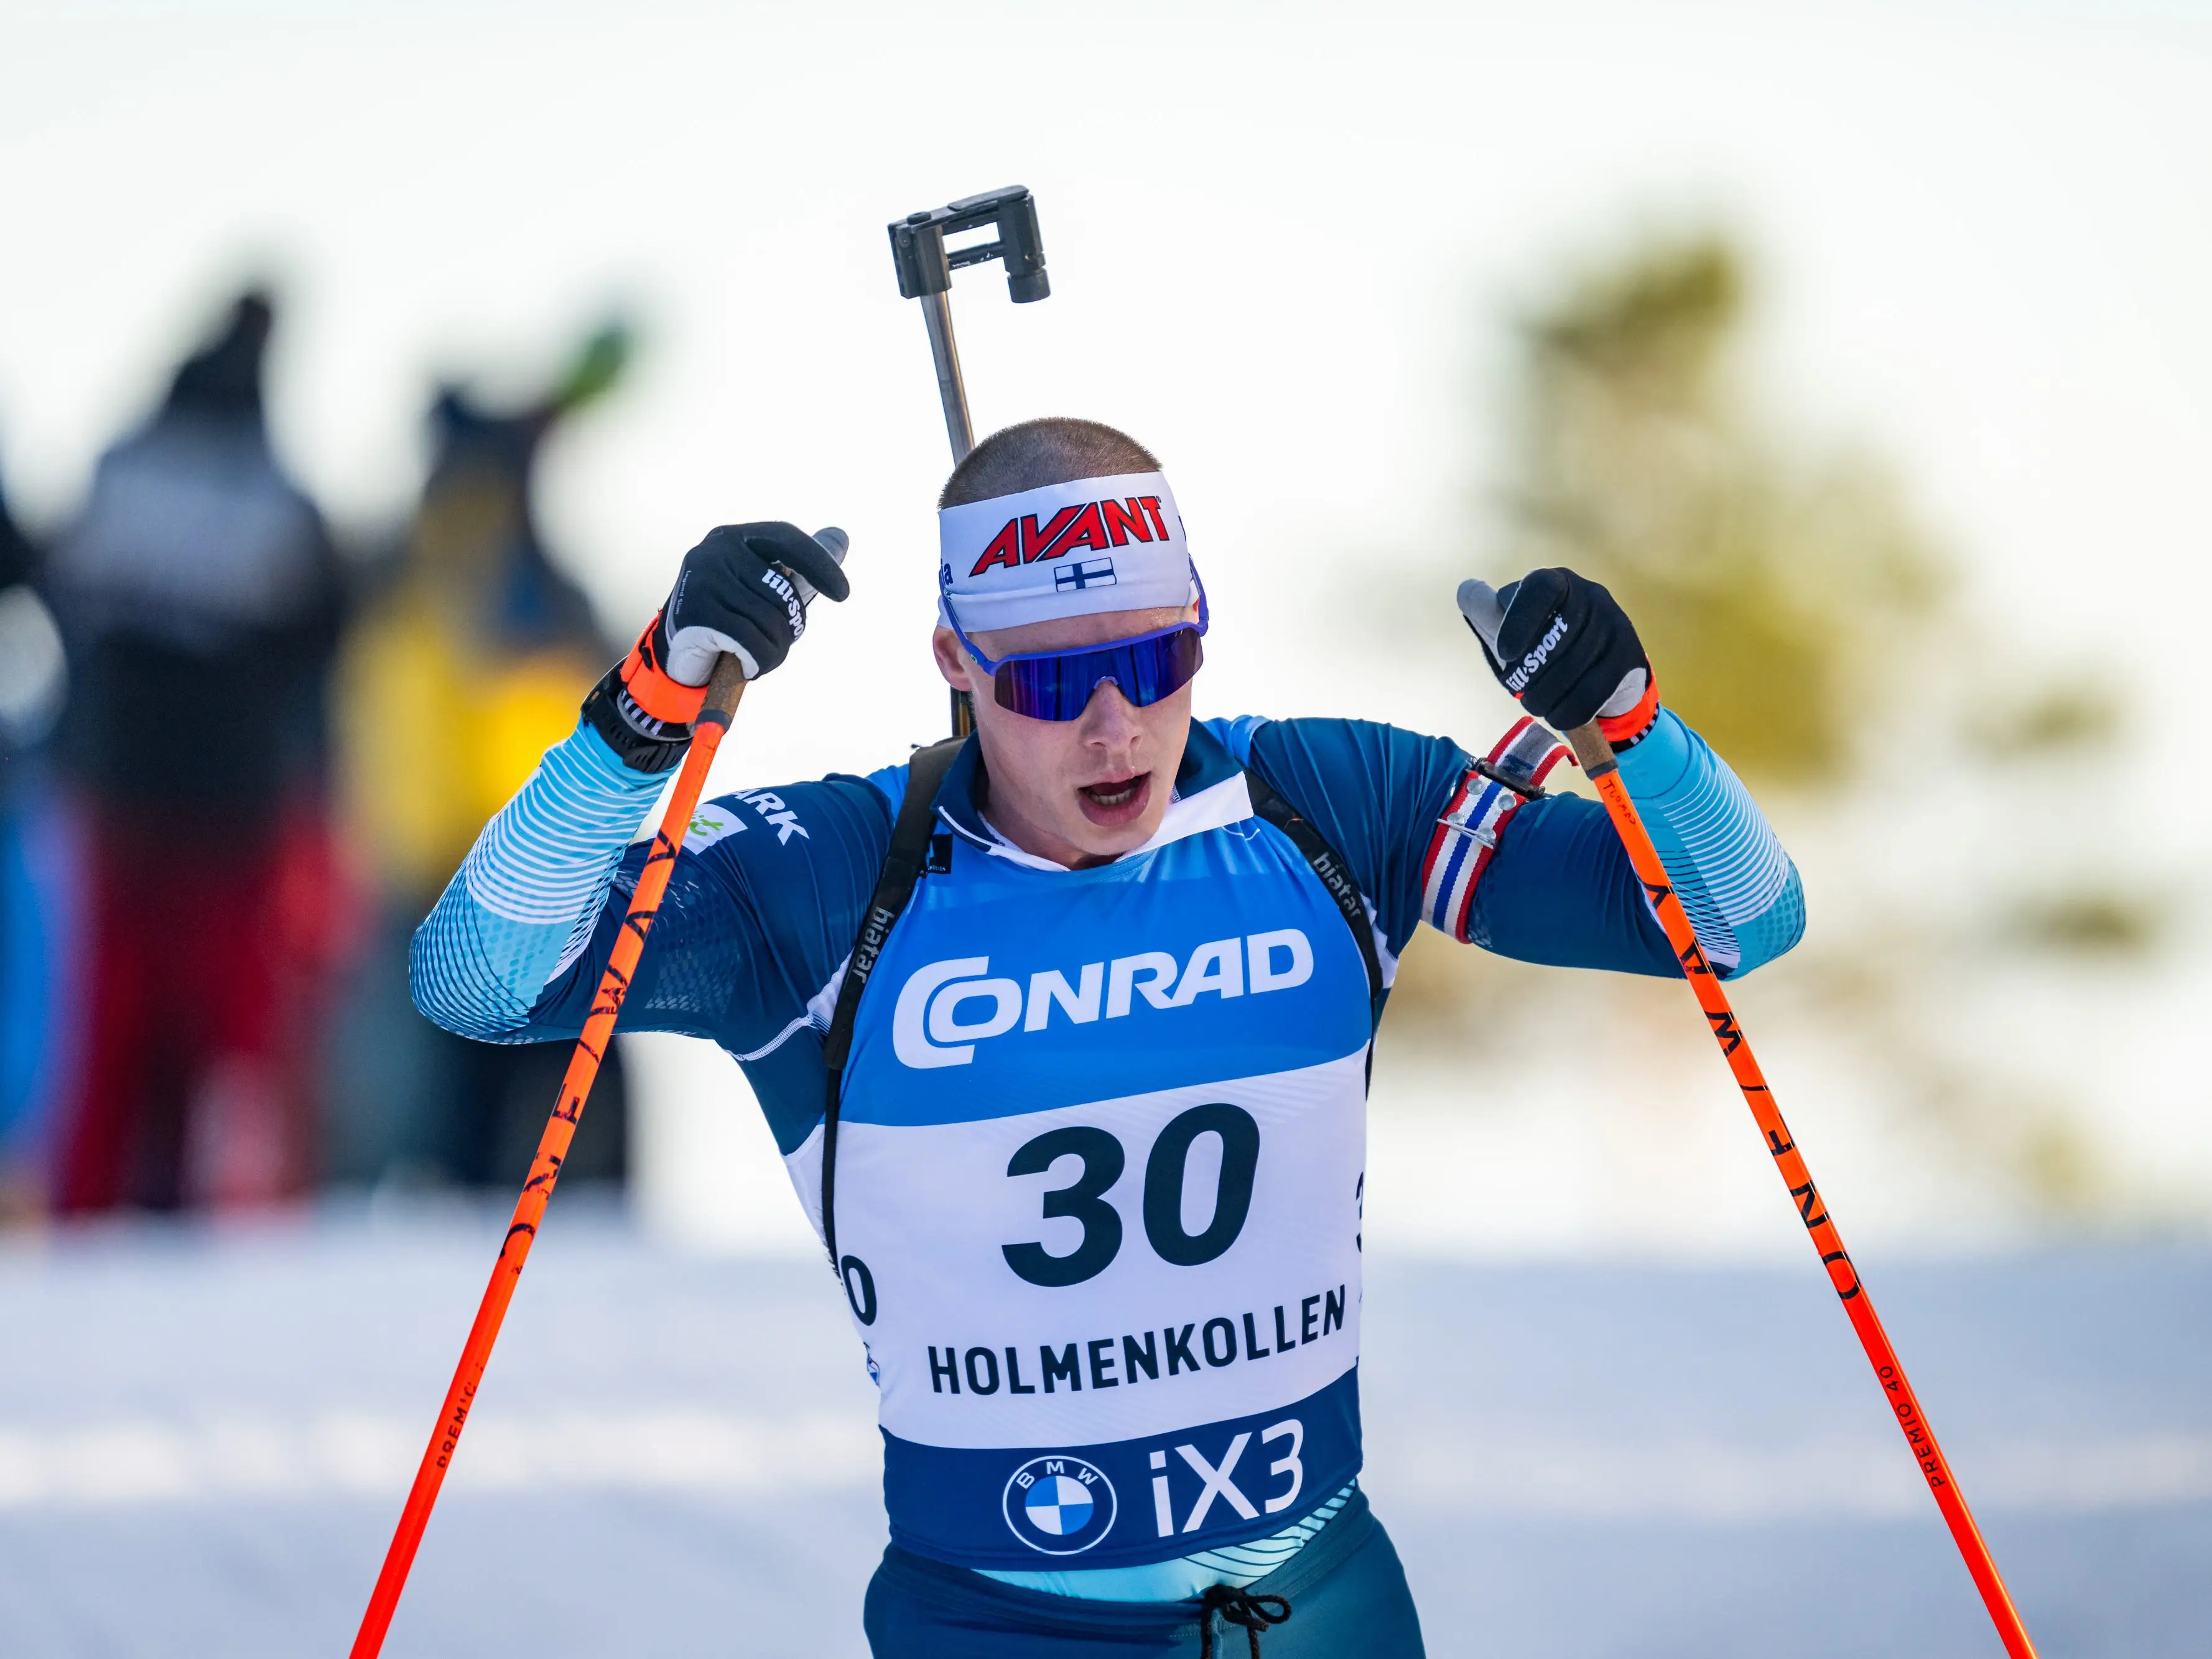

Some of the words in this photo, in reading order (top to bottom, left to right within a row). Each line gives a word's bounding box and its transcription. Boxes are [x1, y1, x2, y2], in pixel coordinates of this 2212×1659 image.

[968, 495, 1169, 577] AVANT
[892, 928, 1314, 1069] CONRAD
[1001, 1102, 1260, 1288] 30
[927, 1284, 1346, 1396] HOLMENKOLLEN
[1879, 1365, 1898, 1392] 40
[1016, 1461, 1099, 1489] BMW
[1149, 1418, 1304, 1538] iX3
[1897, 1403, 1946, 1487] PREMIO
